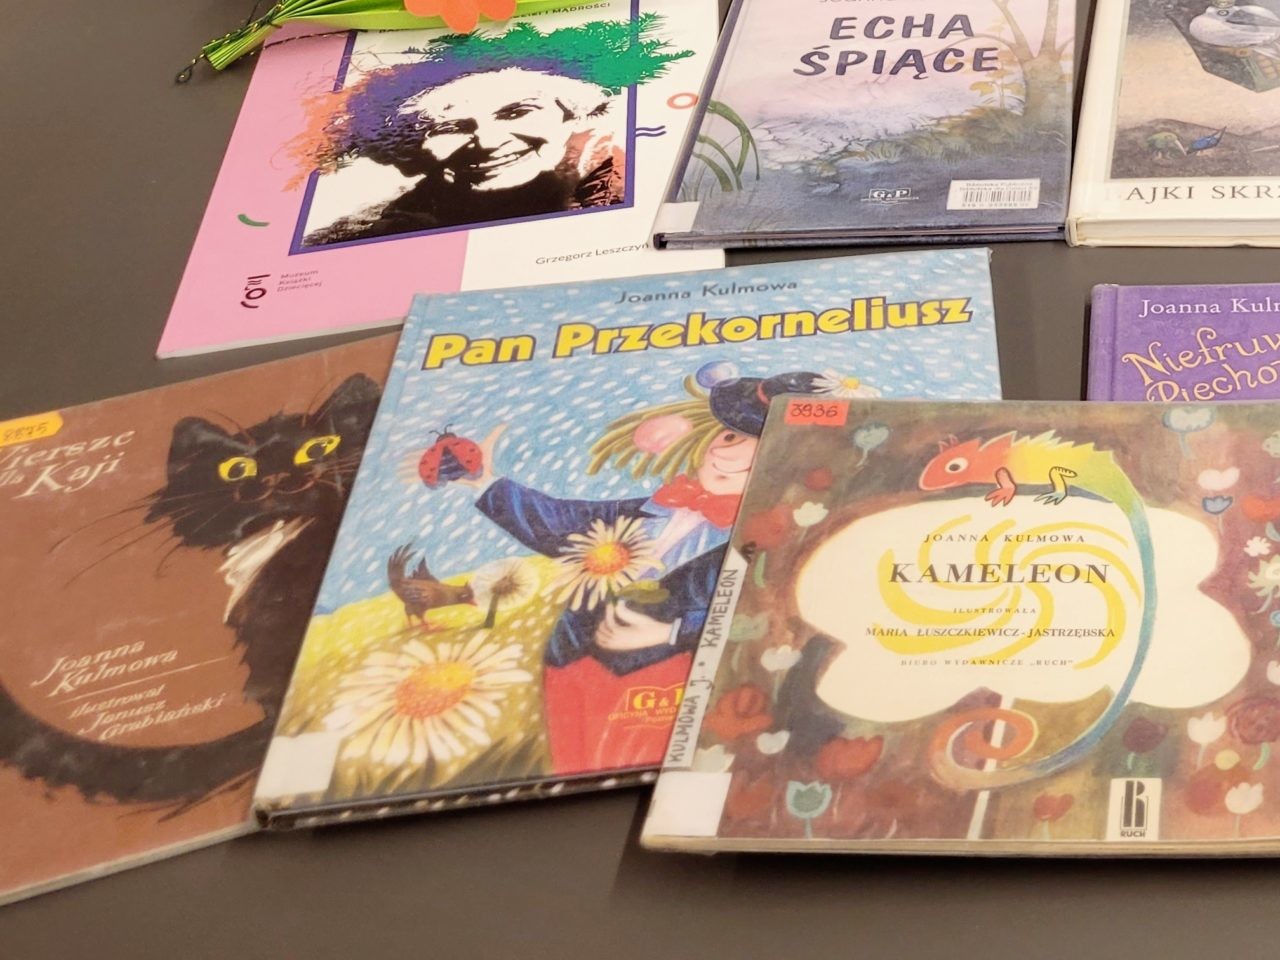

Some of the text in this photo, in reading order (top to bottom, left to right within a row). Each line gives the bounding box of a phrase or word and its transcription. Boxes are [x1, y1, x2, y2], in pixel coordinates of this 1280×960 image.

[552, 2, 610, 14] MĄDROŚCI
[829, 13, 975, 40] ECHA
[793, 45, 999, 80] ŚPIĄCE
[1126, 186, 1195, 204] AJKI
[535, 242, 650, 265] Grzegorz Leszczyń
[615, 280, 799, 305] Joanna Kulmowa
[1138, 299, 1222, 318] Joanna
[422, 296, 973, 371] Pan Przekorneliusz
[791, 403, 838, 419] 3936
[11, 452, 126, 501] Kaji
[924, 533, 1085, 543] JOANNA KULMOWA
[889, 562, 1110, 584] KAMELEON
[865, 627, 908, 638] MARIA
[30, 640, 145, 687] Joanna
[46, 650, 178, 698] Kulmowa
[669, 694, 700, 763] KULMOWA
[701, 569, 738, 649] KAMELEON
[900, 659, 938, 667] BIURO
[944, 658, 1024, 667] WYDAWNICZE
[77, 700, 166, 735] Janusz
[99, 693, 227, 740] Grabiański
[1120, 830, 1146, 838] RUCH
